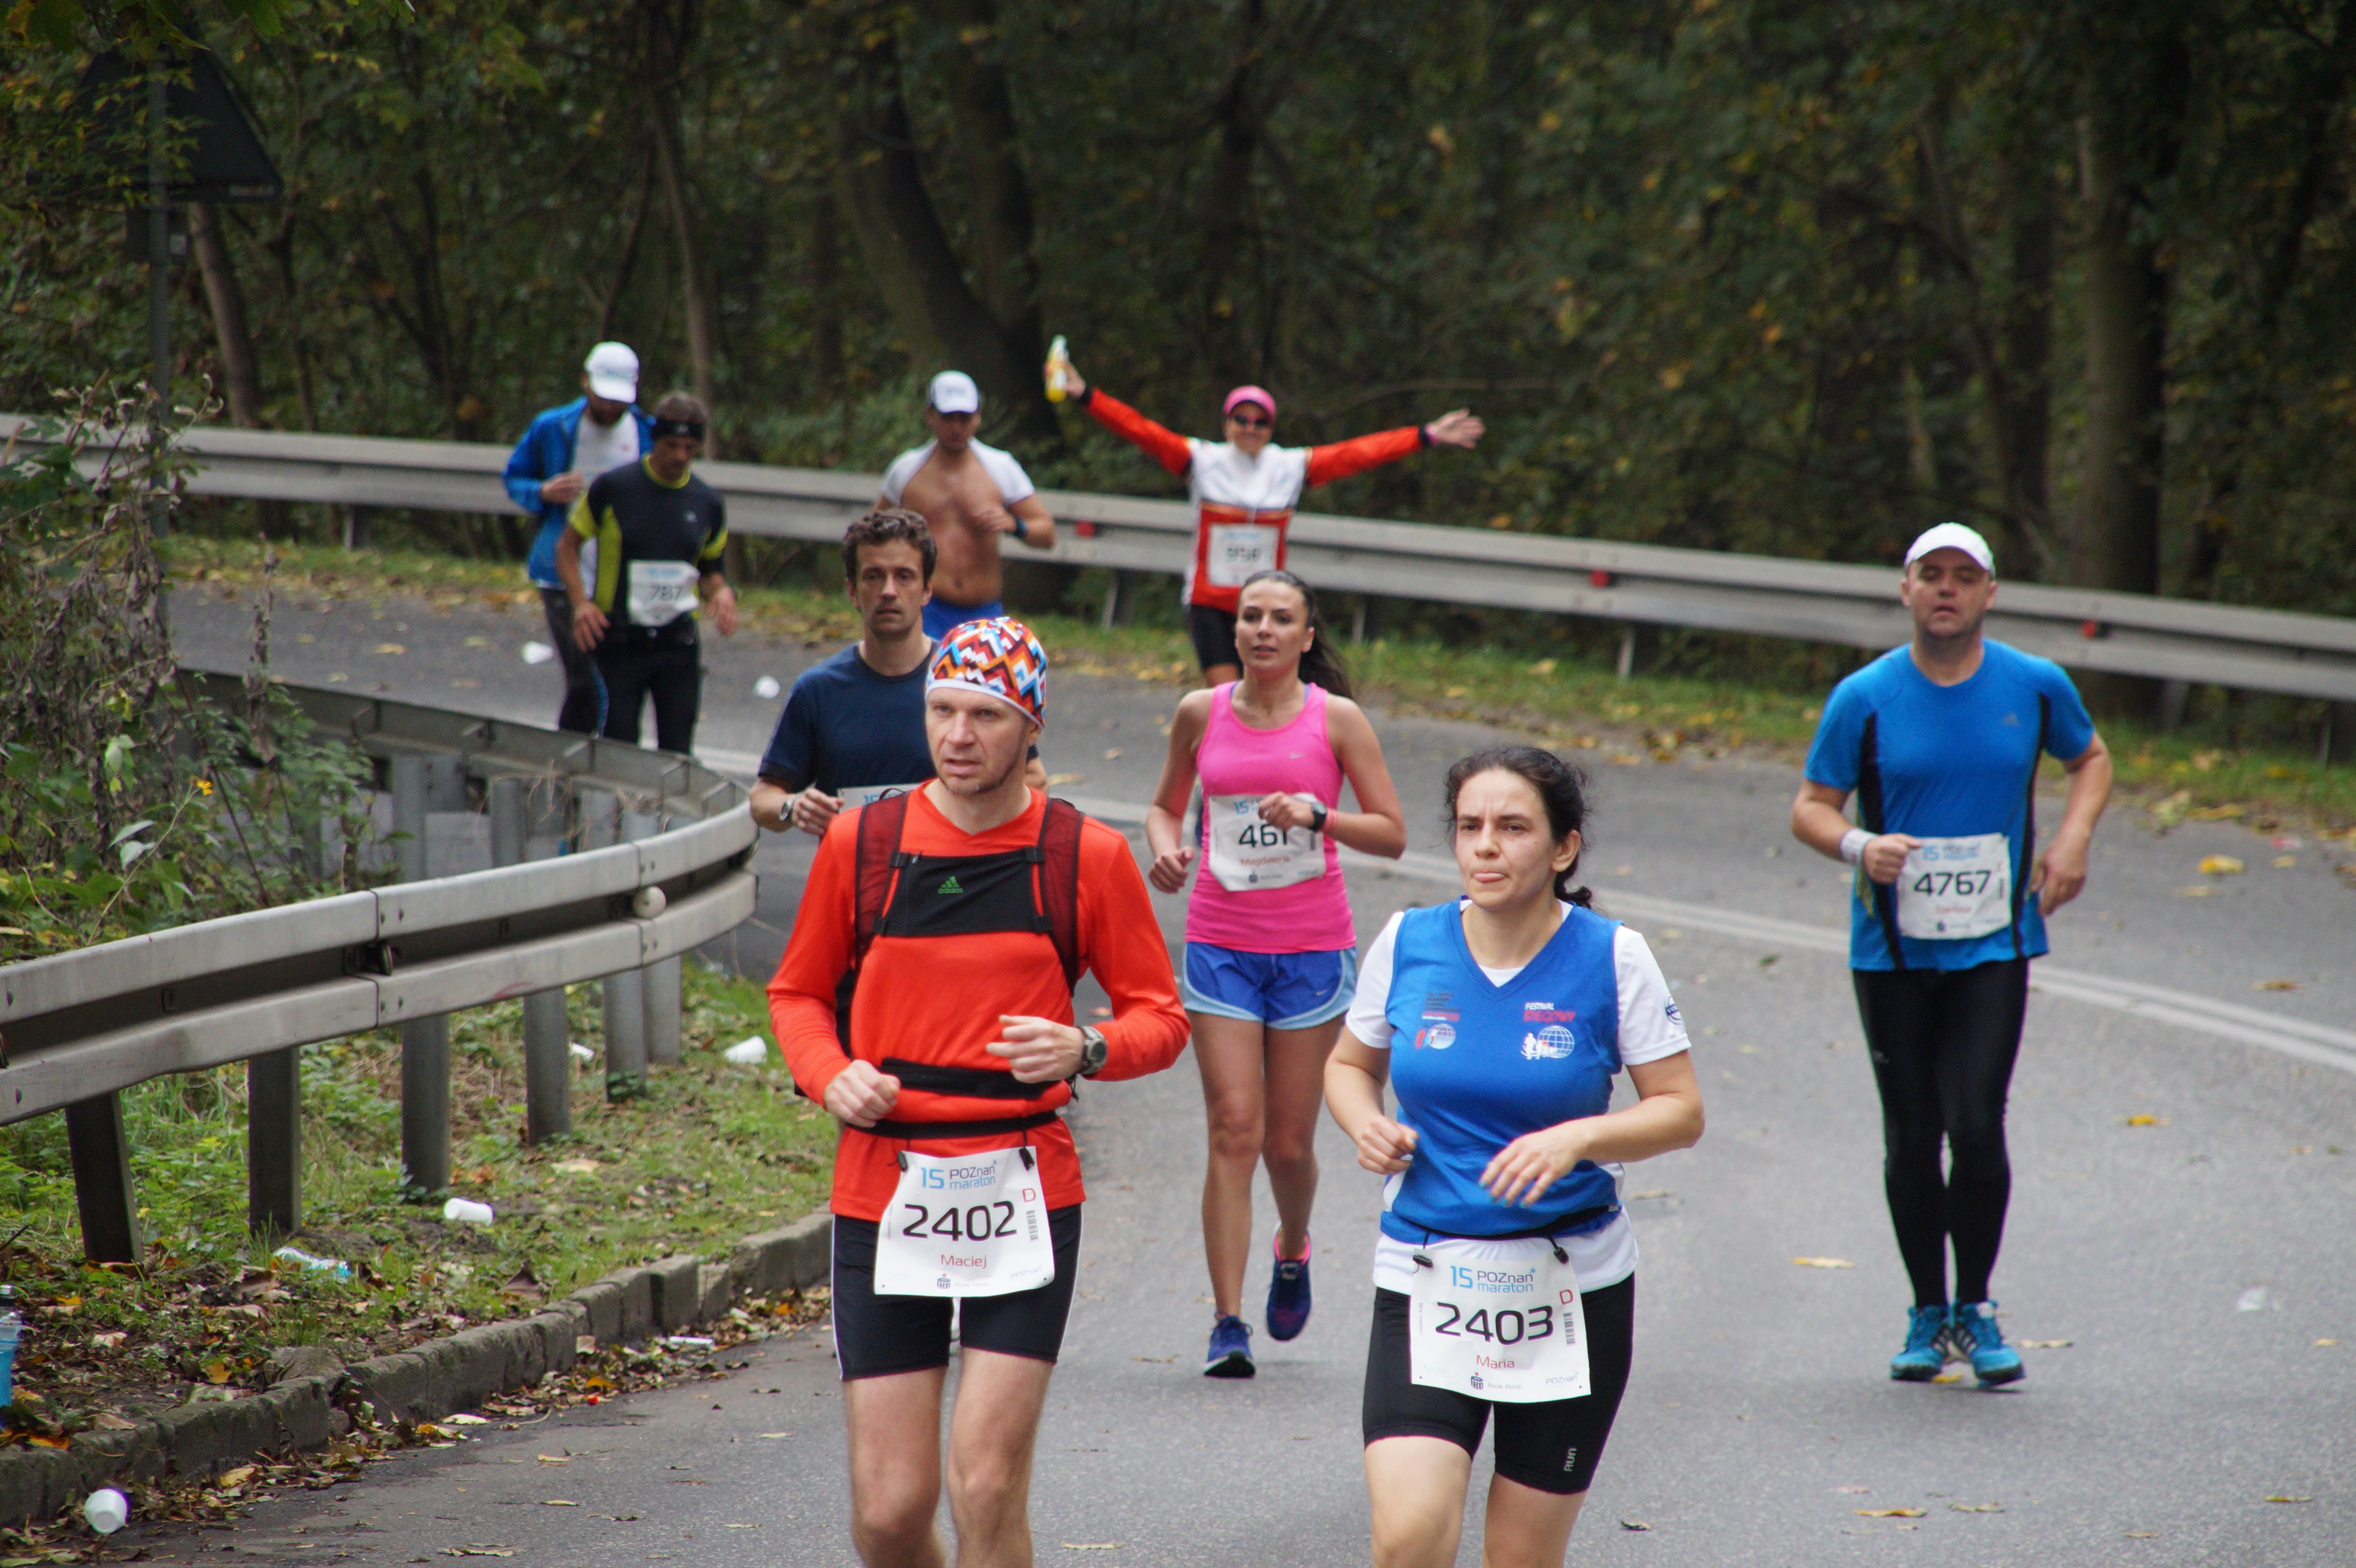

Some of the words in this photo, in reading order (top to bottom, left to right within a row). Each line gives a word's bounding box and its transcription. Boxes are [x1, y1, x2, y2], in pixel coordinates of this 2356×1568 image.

[1234, 800, 1249, 814] 15
[1914, 869, 1991, 896] 4767
[921, 1167, 945, 1189] 15
[950, 1176, 996, 1190] maraton
[1022, 1188, 1036, 1202] D
[903, 1201, 1017, 1242] 2402
[941, 1255, 987, 1269] Maciej
[1450, 1265, 1473, 1289] 15
[1477, 1283, 1533, 1293] maraton
[1559, 1289, 1574, 1305] D
[1435, 1301, 1554, 1345] 2403
[1476, 1355, 1515, 1369] Maria
